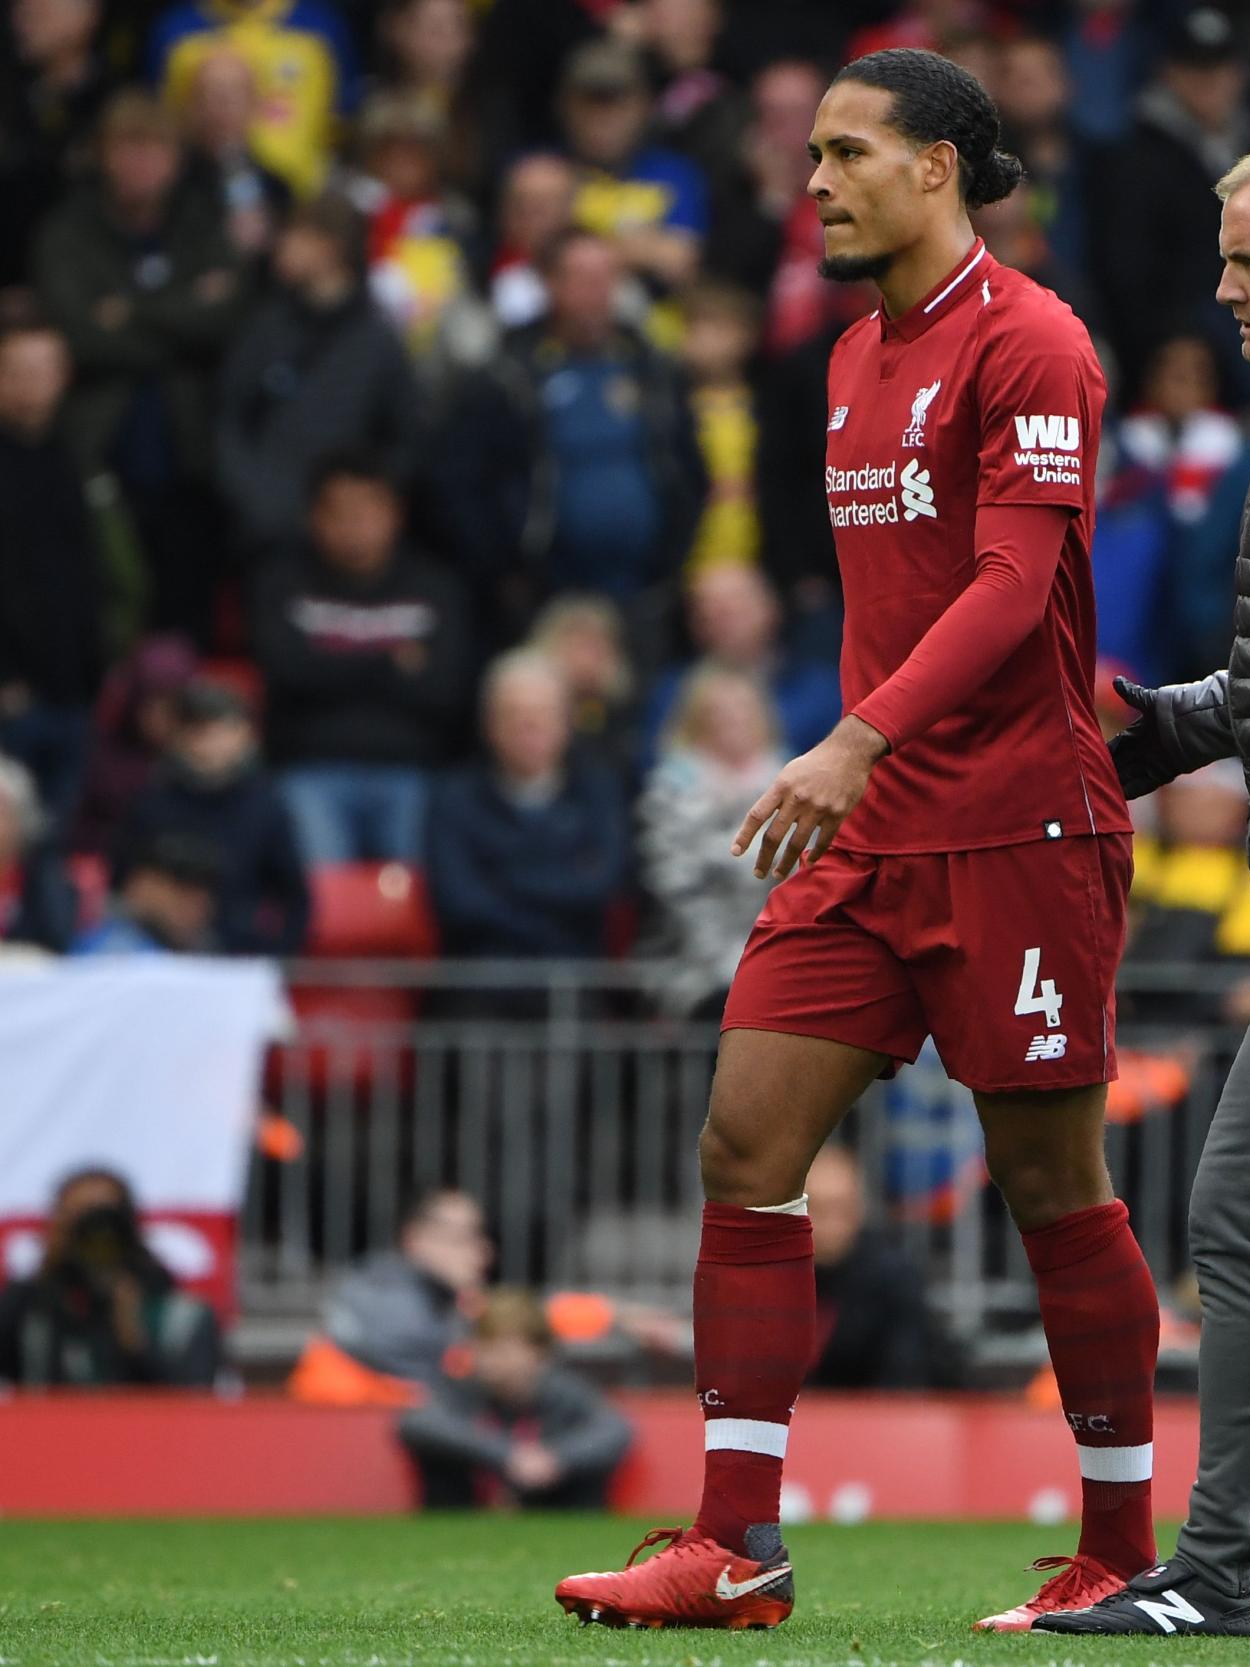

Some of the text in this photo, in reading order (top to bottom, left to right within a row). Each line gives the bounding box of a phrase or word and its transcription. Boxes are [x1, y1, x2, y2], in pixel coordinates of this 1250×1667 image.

[1014, 415, 1079, 451] WU
[1014, 451, 1080, 469] Western
[1033, 467, 1080, 485] Union
[825, 461, 896, 493] Standard
[829, 496, 899, 528] hartered
[1014, 947, 1063, 1028] 4
[1133, 1589, 1206, 1633] N
